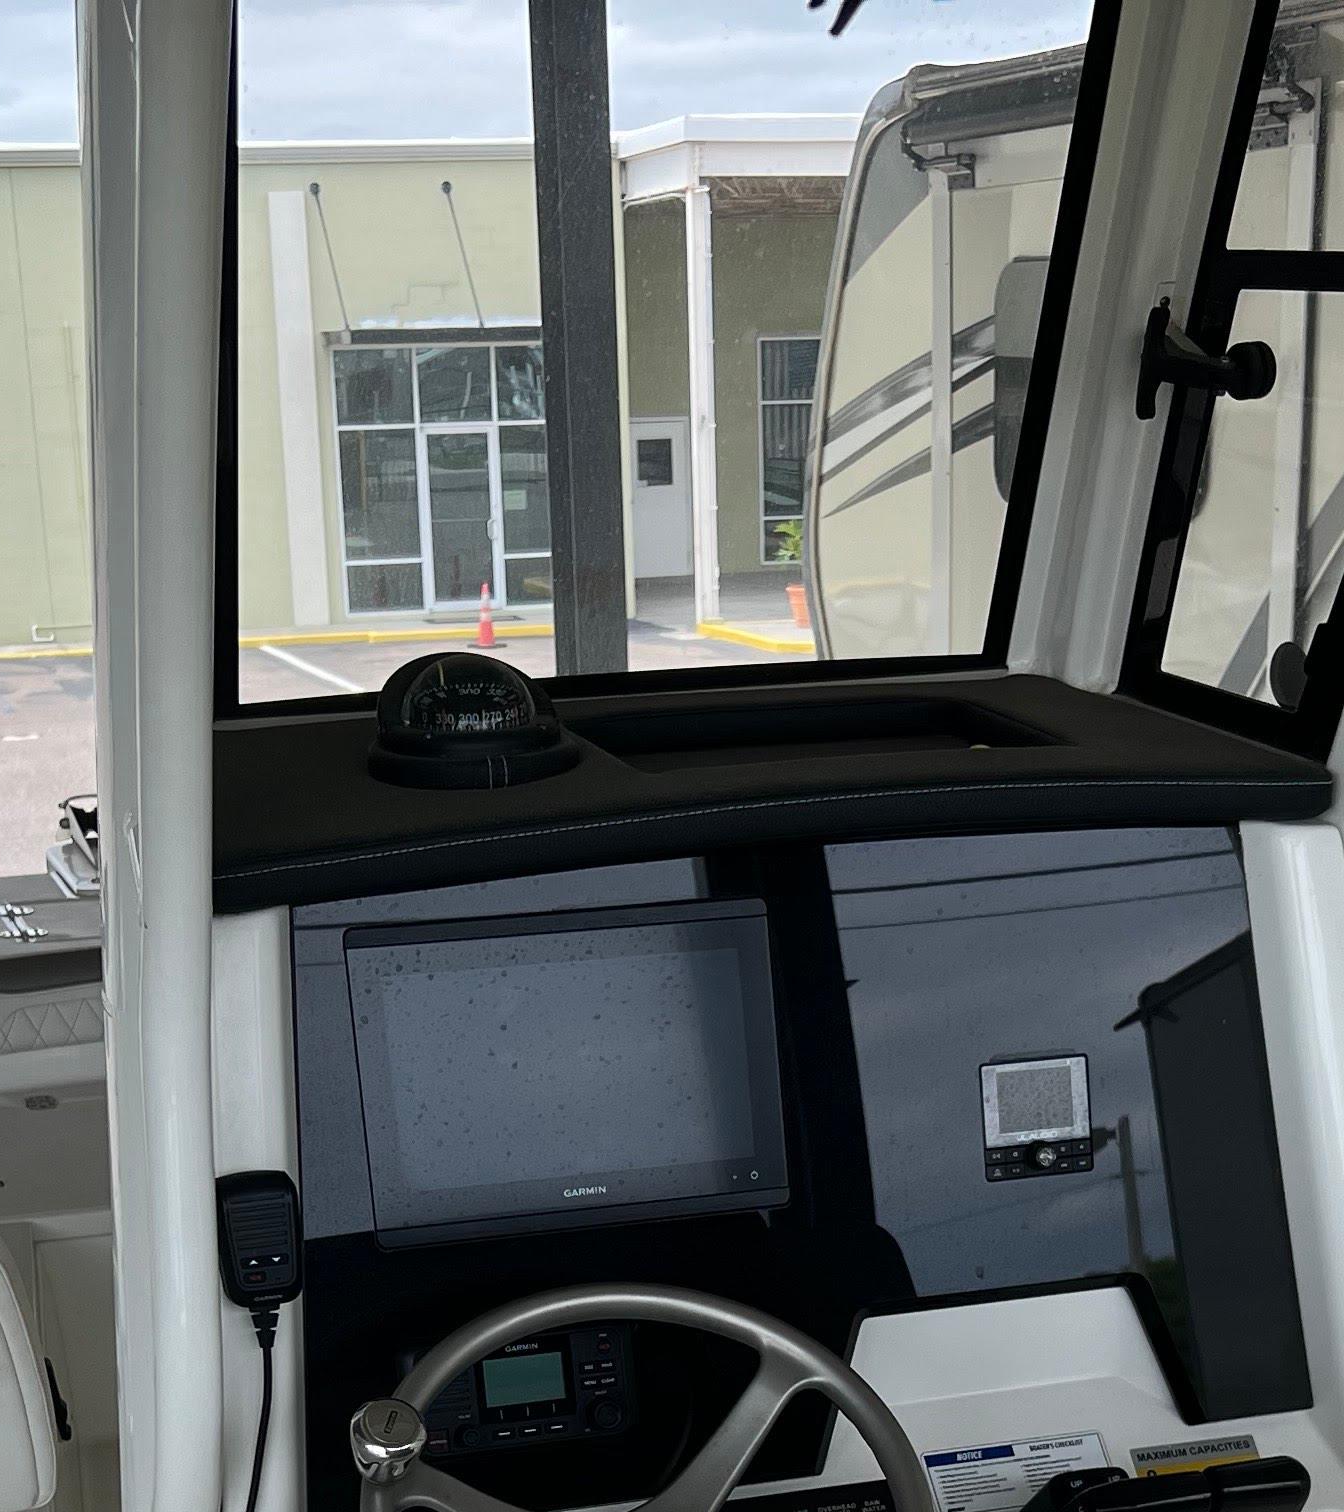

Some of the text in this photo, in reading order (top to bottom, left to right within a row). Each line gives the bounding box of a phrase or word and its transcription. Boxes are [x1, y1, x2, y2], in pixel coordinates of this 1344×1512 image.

[563, 1185, 607, 1198] GARMIN
[504, 1342, 539, 1353] GARMIN
[956, 1450, 983, 1462] NOTICE
[1135, 1439, 1251, 1463] MAXIMUM CAPACITIES
[817, 1503, 857, 1512] OVERHEAD
[860, 1504, 887, 1512] WATER
